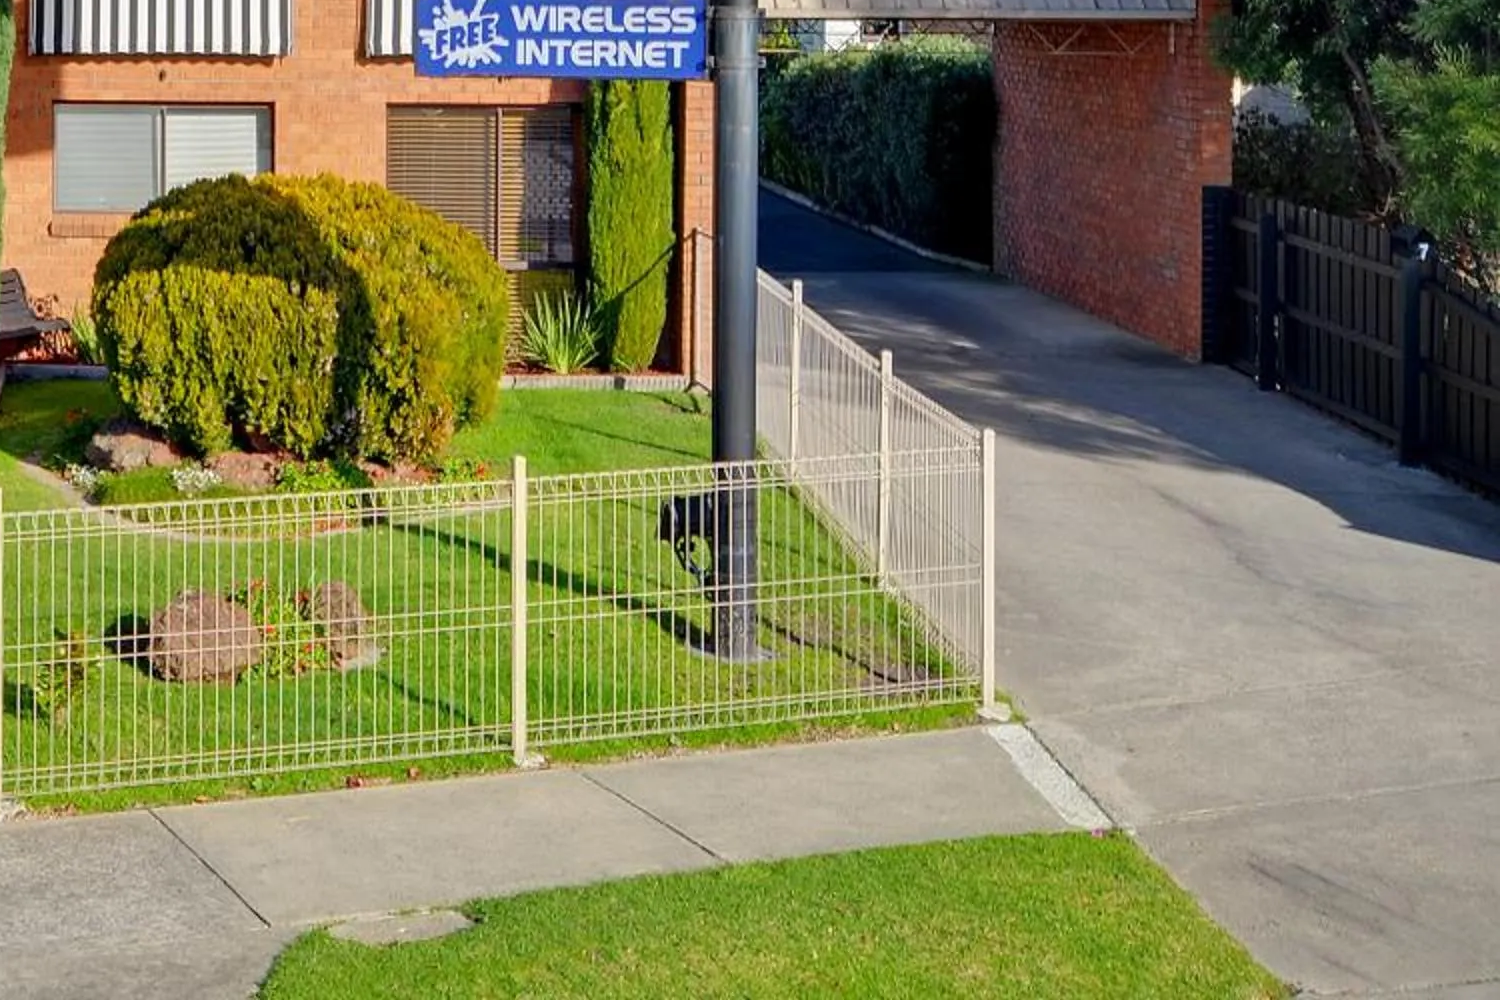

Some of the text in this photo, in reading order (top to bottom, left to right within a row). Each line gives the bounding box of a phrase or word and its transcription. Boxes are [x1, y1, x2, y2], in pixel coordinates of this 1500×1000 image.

[510, 5, 697, 34] WIRELESS
[434, 18, 497, 52] FREE
[516, 39, 690, 69] INTERNET
